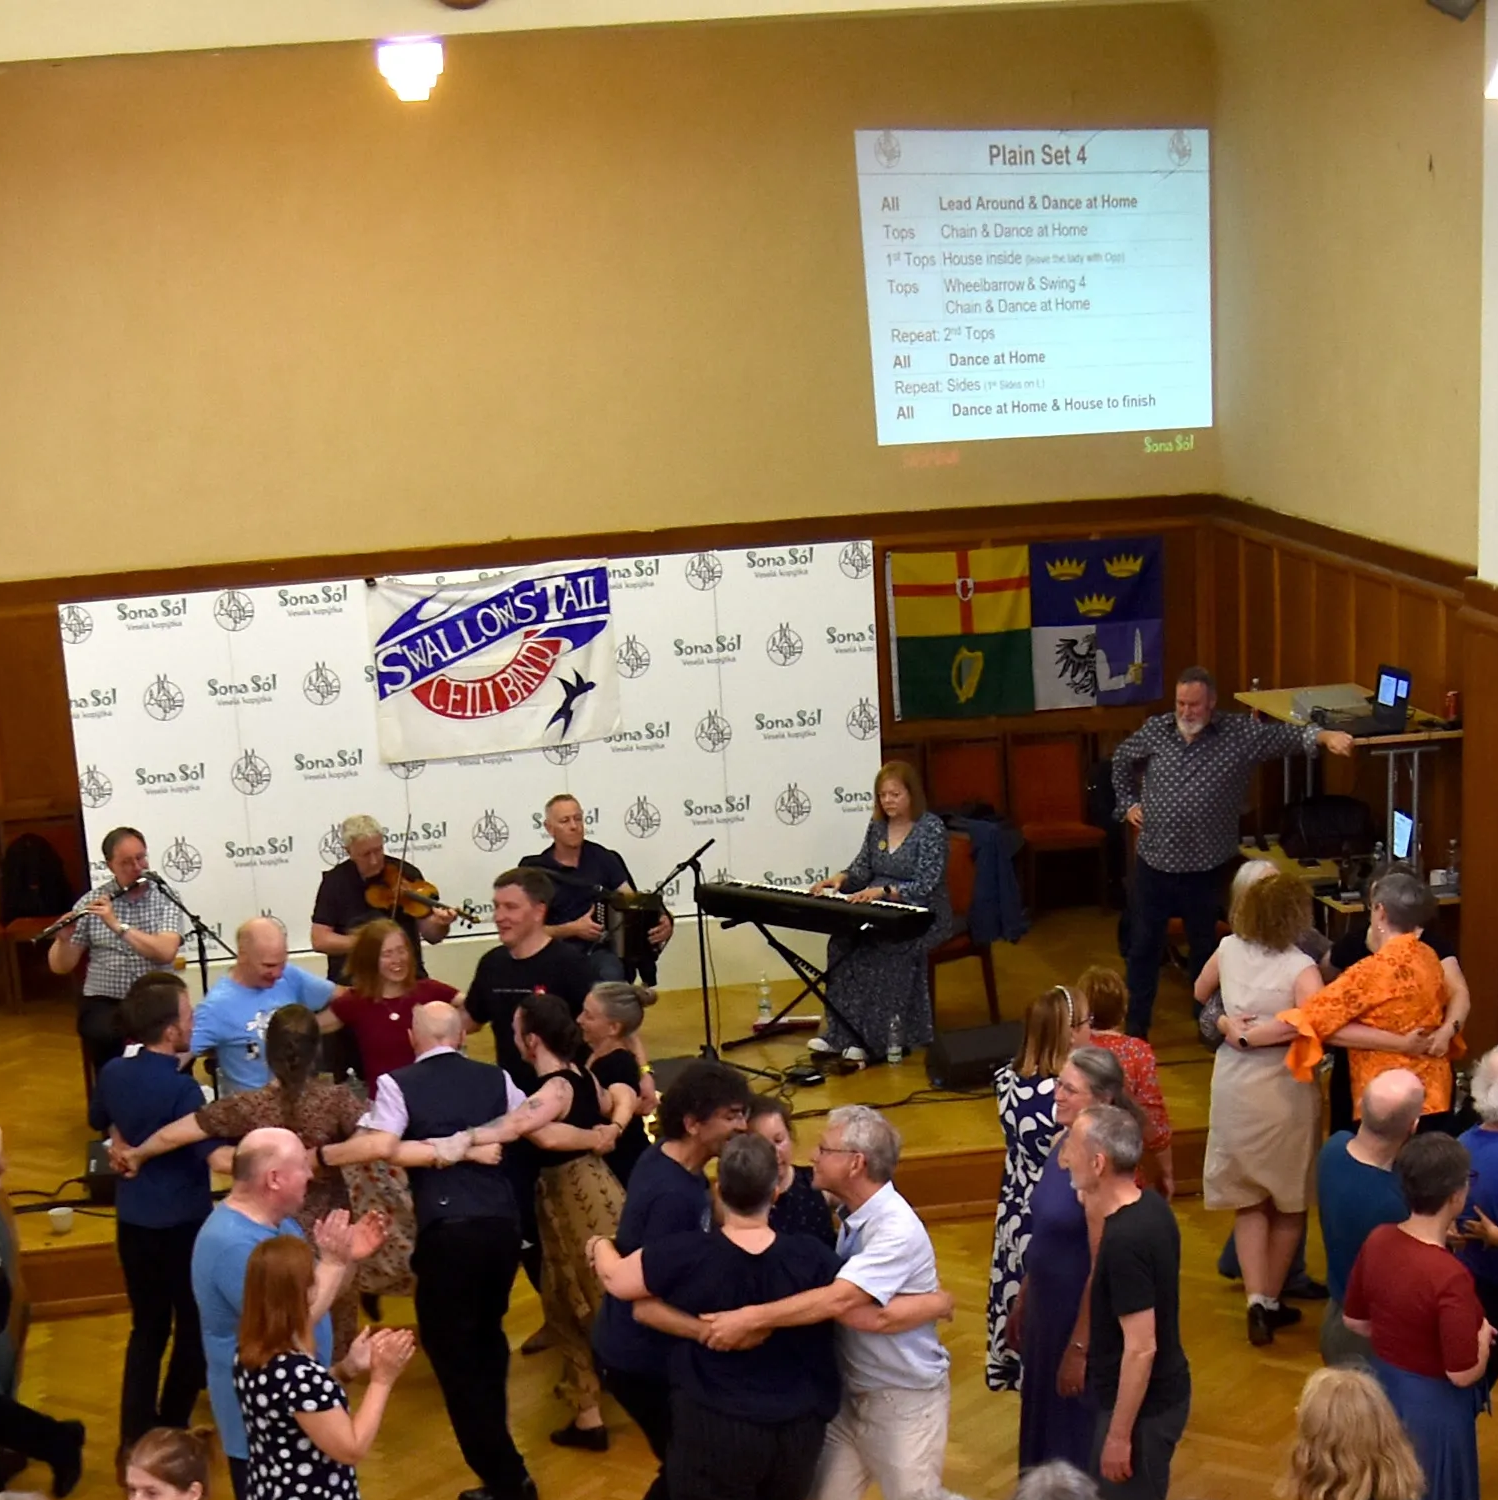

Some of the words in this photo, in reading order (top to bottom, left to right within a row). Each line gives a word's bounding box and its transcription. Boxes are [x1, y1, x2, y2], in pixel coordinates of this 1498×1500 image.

[988, 144, 1036, 166] Plain
[1041, 144, 1071, 166] Set
[1076, 145, 1088, 165] 4
[881, 196, 900, 211] All
[938, 196, 972, 211] Lead
[976, 196, 1025, 211] Around
[1028, 196, 1038, 210] &
[1042, 195, 1082, 210] Dance
[1086, 195, 1098, 209] at
[1101, 194, 1138, 209] Home
[883, 224, 916, 243] Tops
[941, 223, 977, 239] Chain
[981, 223, 990, 238] &
[993, 223, 1033, 238] Dance
[1037, 224, 1049, 237] at
[1052, 222, 1088, 237] Home
[905, 252, 936, 269] Tops
[942, 252, 983, 266] House
[986, 251, 1022, 265] inside
[887, 279, 919, 296] Tops
[943, 278, 1025, 293] Wheelbarrow
[1027, 277, 1036, 290] &
[1039, 276, 1076, 293] Swing
[1079, 275, 1086, 288] 4
[945, 299, 982, 314] Chain
[985, 299, 994, 313] &
[998, 298, 1037, 313] Dance
[1040, 299, 1053, 312] at
[1055, 297, 1091, 311] Home
[891, 328, 941, 345] Repeat:
[965, 326, 996, 343] Tops
[893, 354, 911, 369] All
[949, 353, 990, 367] Dance
[993, 352, 1006, 366] at
[1009, 351, 1046, 365] Home
[894, 379, 943, 396] Repeat:
[947, 378, 982, 393] Sides
[897, 406, 915, 420] All
[952, 403, 993, 417] Dance
[996, 402, 1008, 415] at
[1011, 400, 1048, 414] Home
[1051, 398, 1061, 412] &
[1064, 397, 1104, 411] House
[1107, 397, 1120, 409] to
[1122, 394, 1156, 408] finish
[634, 558, 660, 577] Sól
[746, 551, 786, 568] Sona
[788, 546, 814, 565] Sól
[277, 589, 320, 607] Sona
[321, 584, 347, 603] Sól
[116, 603, 159, 621] Sona
[160, 597, 187, 617] Sól
[376, 588, 538, 694] SWALLOW'S
[534, 576, 608, 621] TAIL
[673, 638, 714, 656] Sona
[716, 634, 742, 653] Sól
[826, 626, 866, 644] Sona
[207, 678, 249, 696] Sona
[250, 673, 277, 693] Sól
[429, 675, 498, 717] CEILI
[498, 642, 552, 707] BAND
[90, 687, 117, 707] Sól
[645, 721, 670, 740] Sól
[755, 713, 794, 731] Sona
[796, 709, 821, 726] Sól
[294, 753, 335, 771] Sona
[337, 748, 363, 767] Sól
[135, 768, 177, 786] Sona
[178, 762, 205, 781] Sól
[683, 799, 723, 816] Sona
[724, 794, 750, 813] Sól
[834, 786, 873, 804] Sona
[584, 807, 599, 825] ól
[421, 821, 447, 840] Sól
[225, 841, 266, 859] Sona
[268, 836, 293, 854] Sól
[763, 871, 802, 886] Sona
